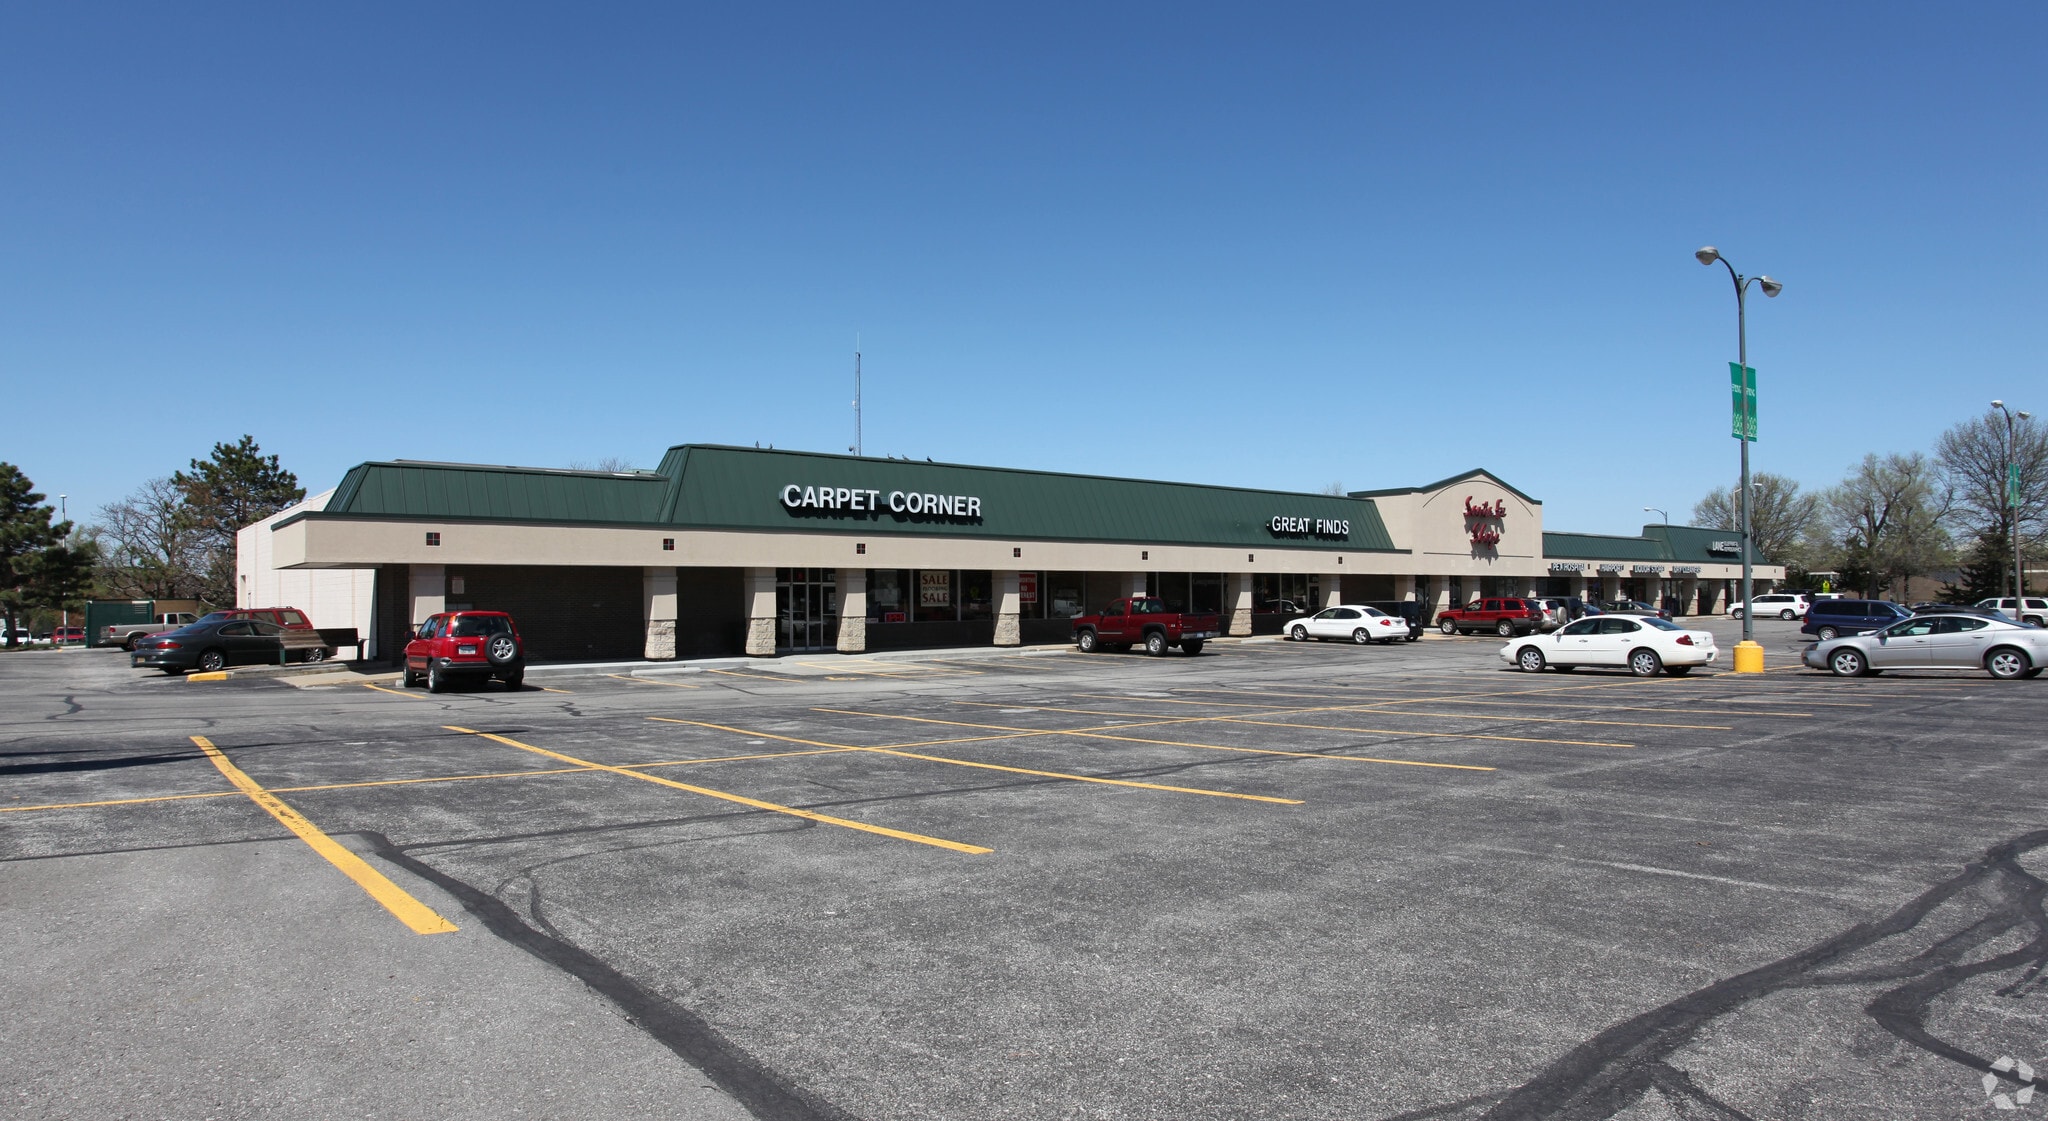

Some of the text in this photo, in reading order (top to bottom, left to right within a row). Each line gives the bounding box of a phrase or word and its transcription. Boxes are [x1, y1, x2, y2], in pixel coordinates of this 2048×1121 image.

[783, 485, 981, 517] CARPET CORNER
[1272, 515, 1349, 535] GREAT FINDS
[922, 575, 948, 585] SALE
[922, 592, 948, 603] SALE
